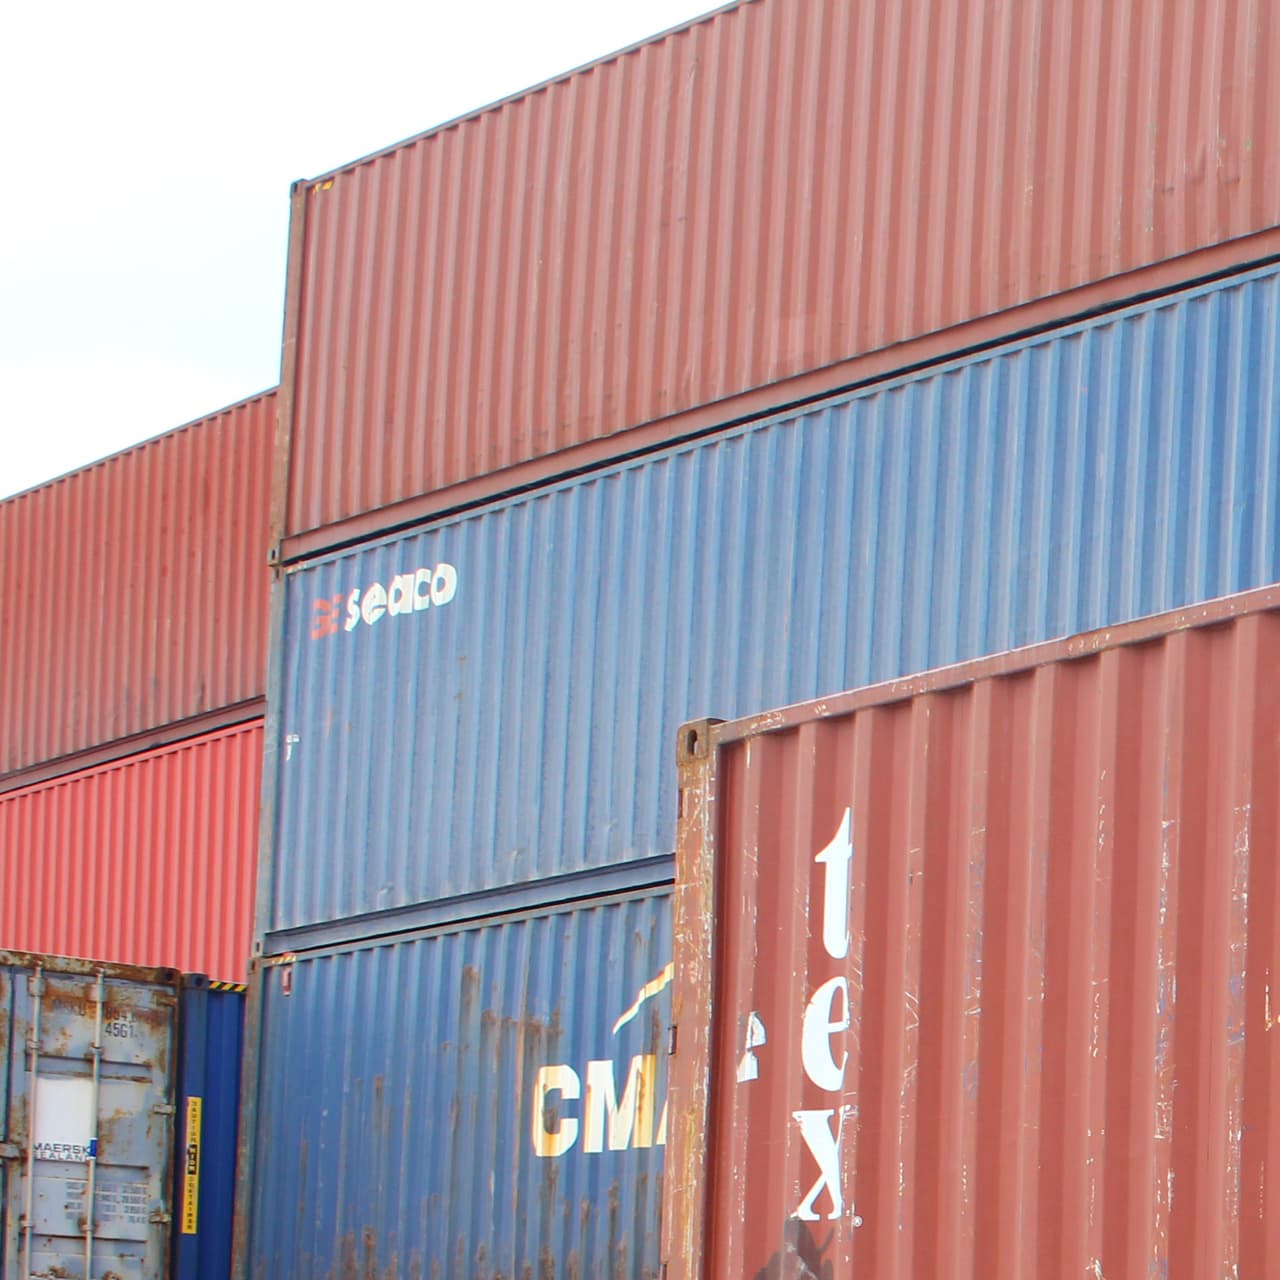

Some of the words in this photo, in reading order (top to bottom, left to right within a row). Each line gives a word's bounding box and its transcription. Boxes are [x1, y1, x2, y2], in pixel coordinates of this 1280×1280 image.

[344, 563, 457, 632] seaco
[791, 806, 854, 1222] tex
[532, 1054, 667, 1157] CM
[34, 1151, 92, 1163] EALAN
